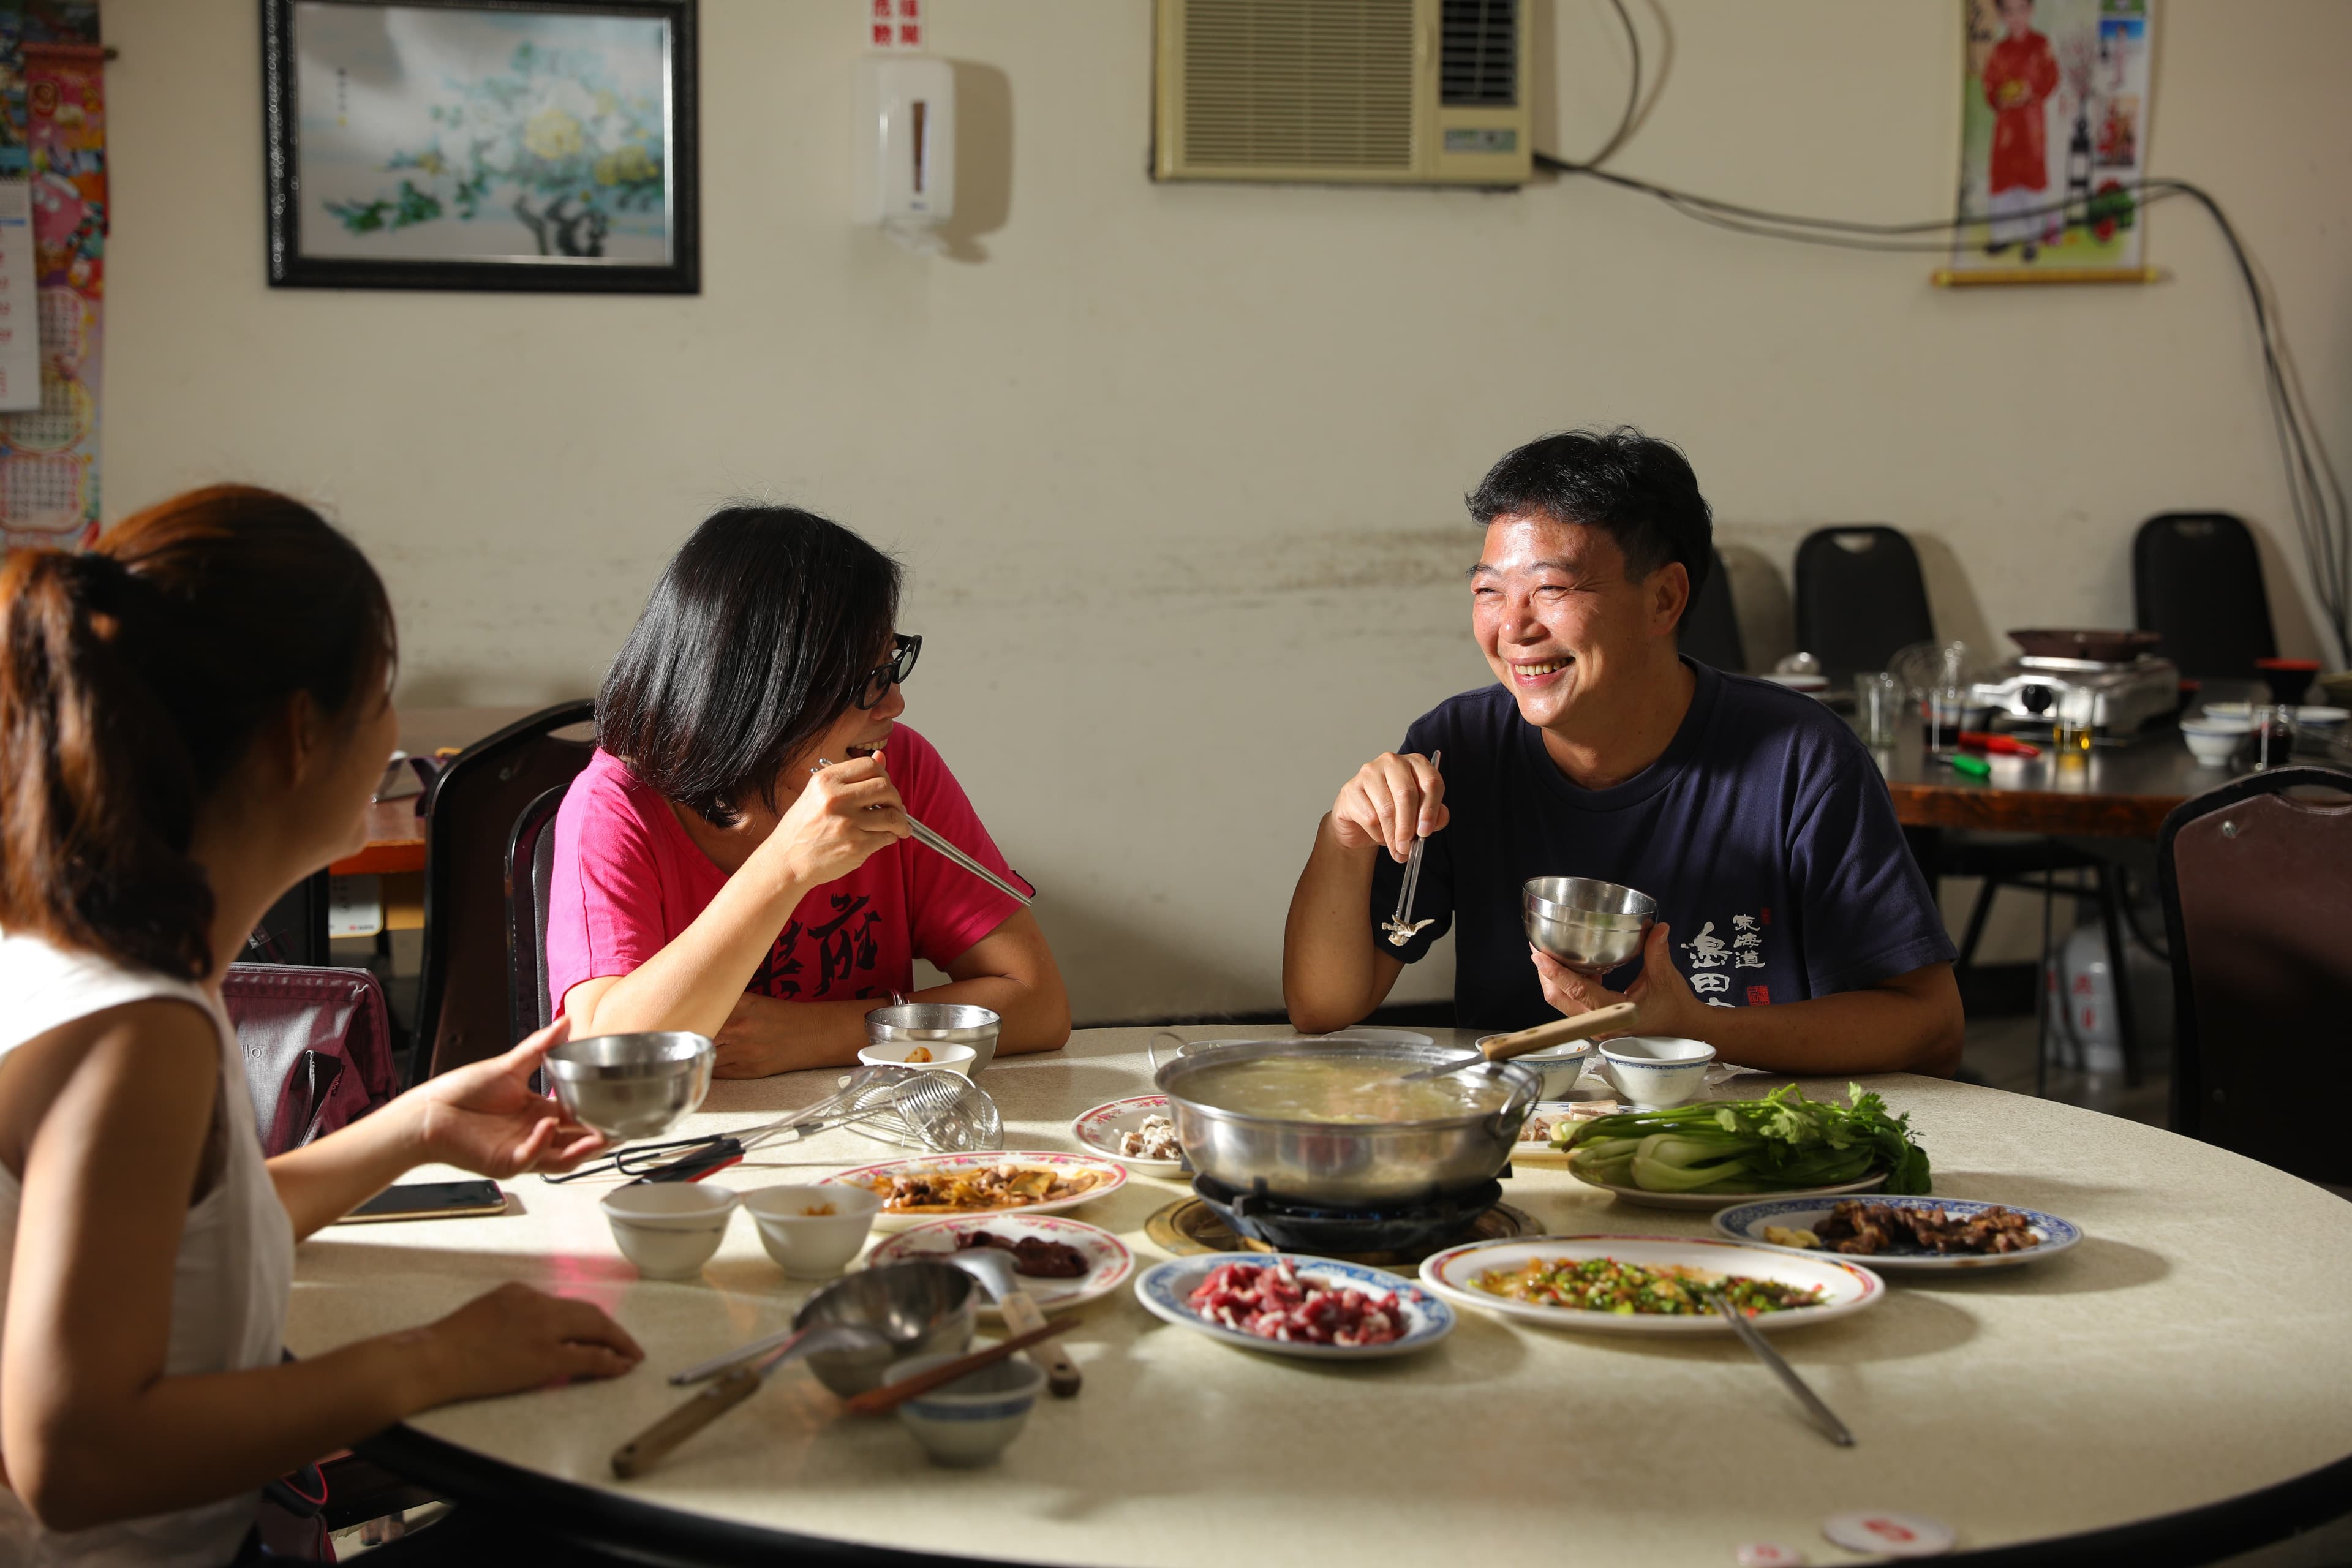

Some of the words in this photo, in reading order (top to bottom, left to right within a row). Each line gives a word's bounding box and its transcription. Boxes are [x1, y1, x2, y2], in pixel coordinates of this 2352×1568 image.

[1680, 921, 1735, 1008] 島田
[1732, 914, 1765, 969] 東海道
[241, 1044, 262, 1059] llo
